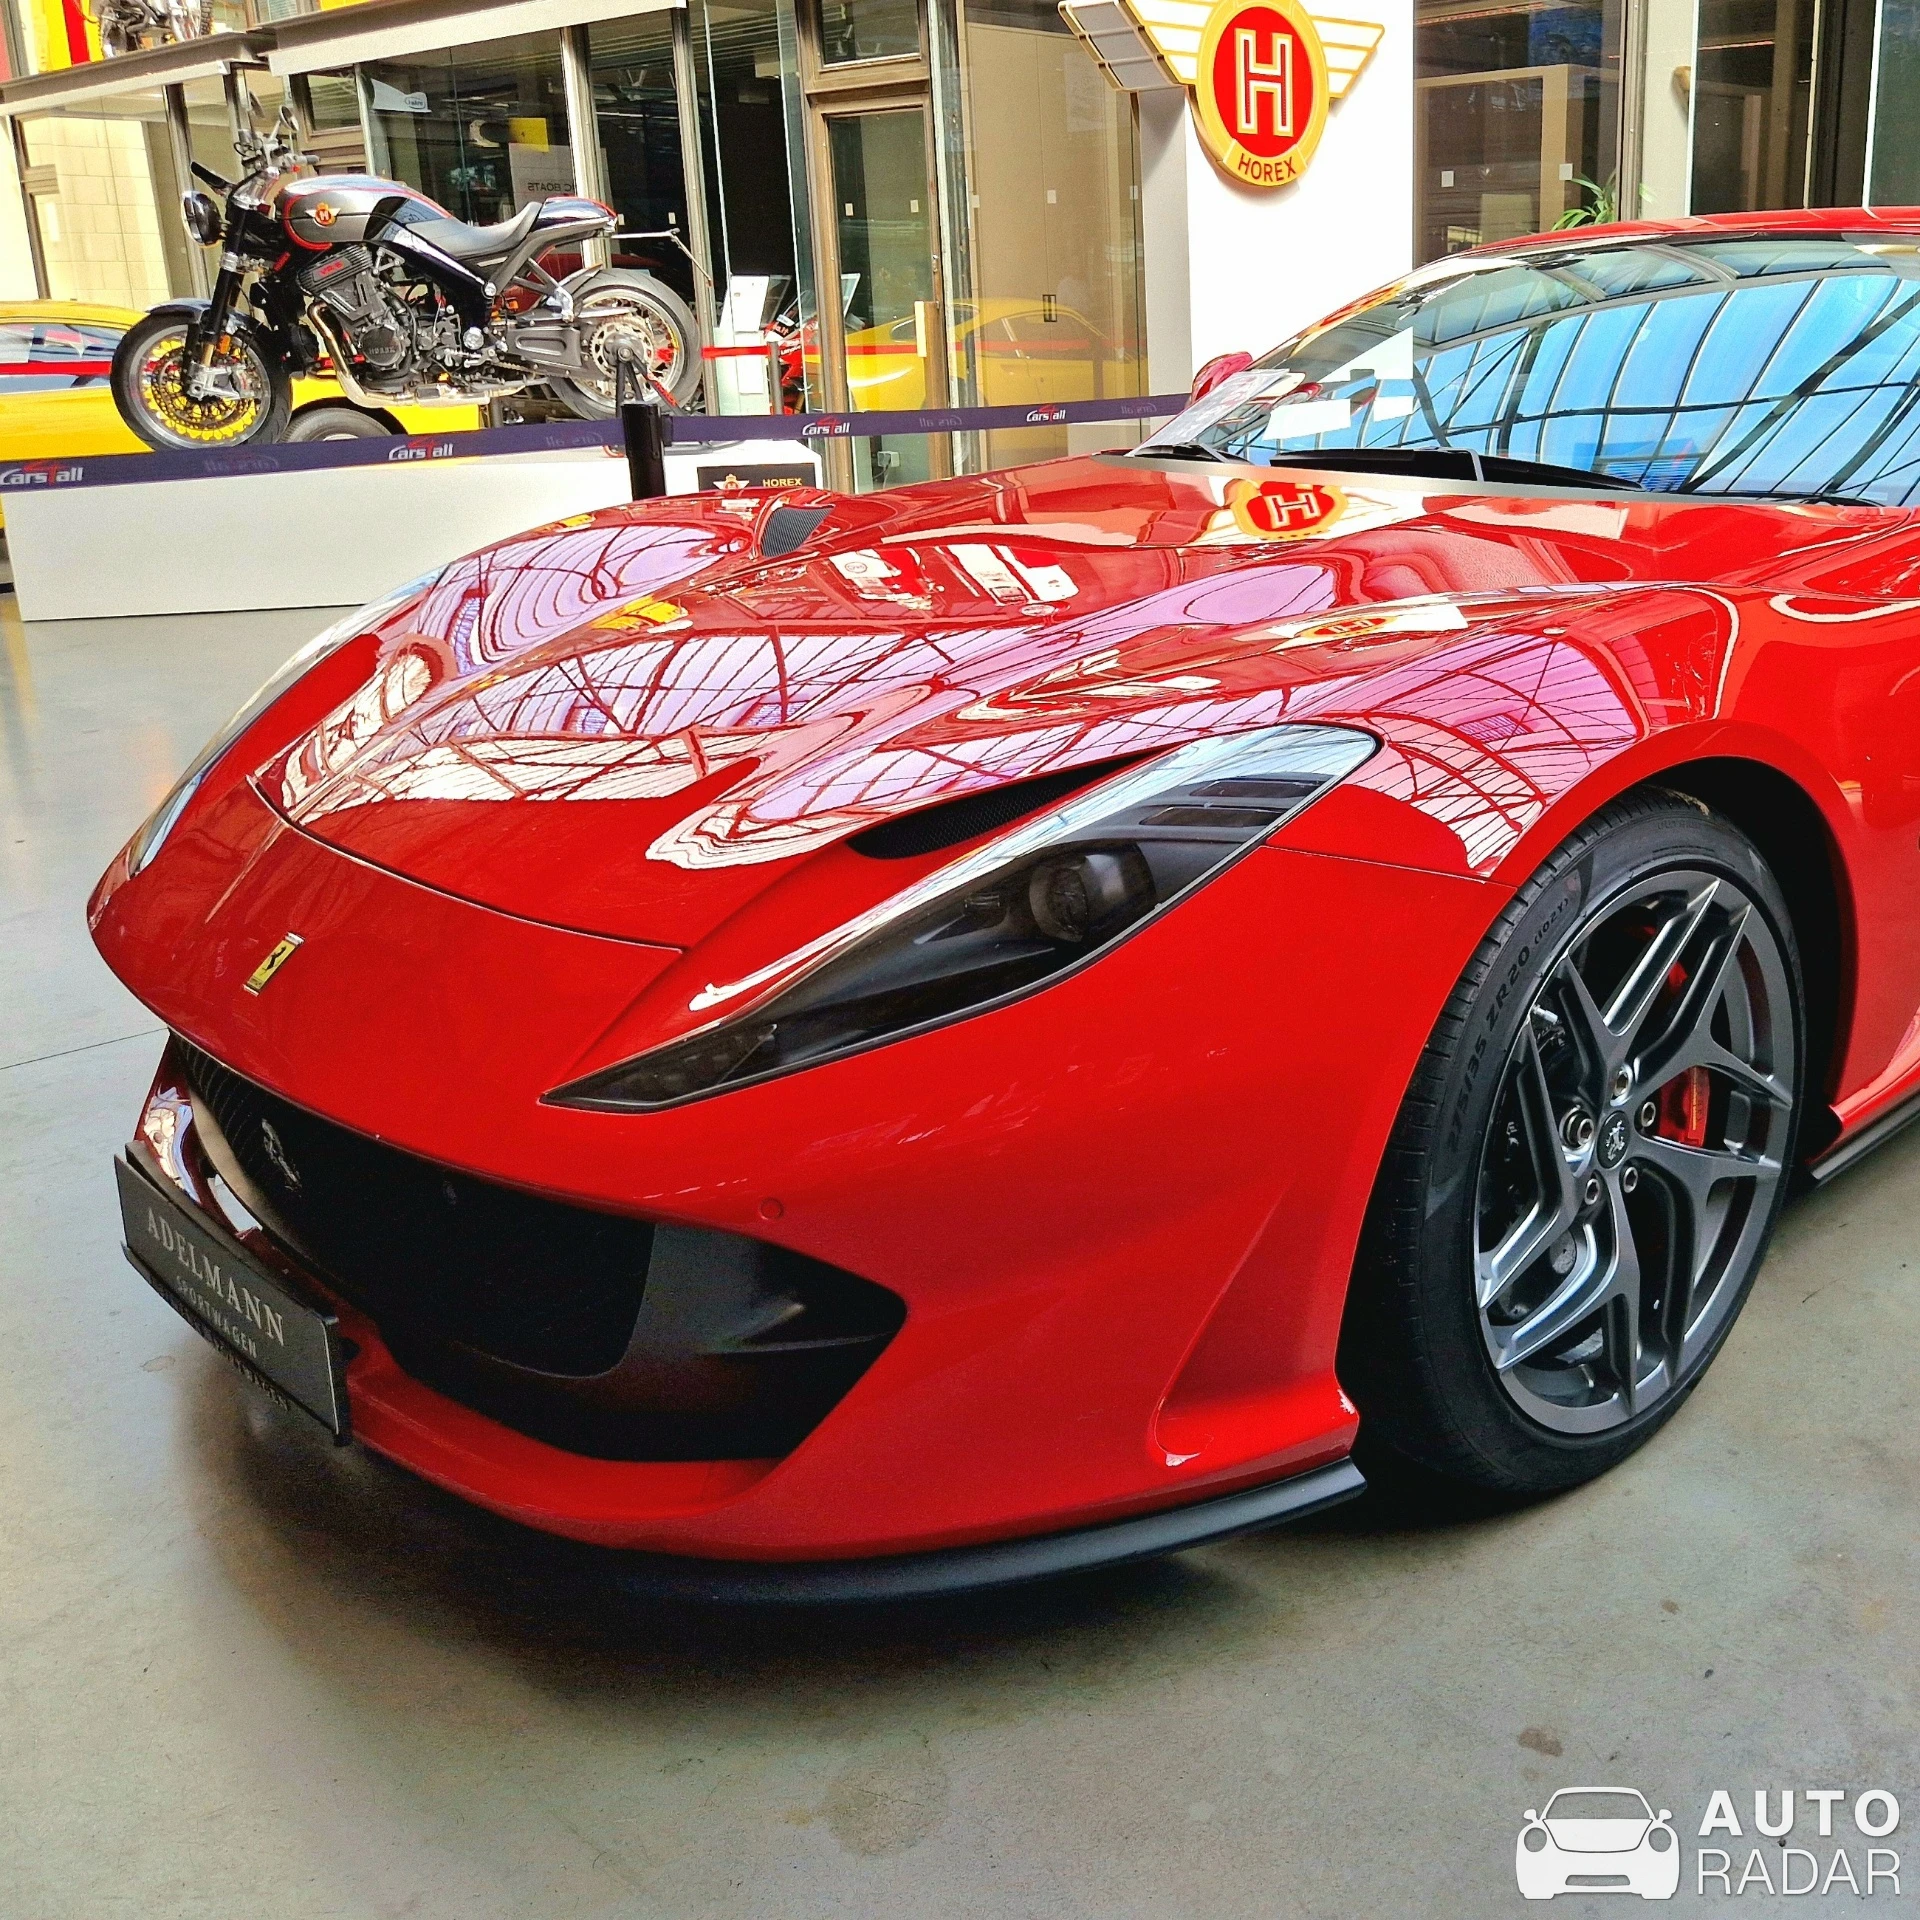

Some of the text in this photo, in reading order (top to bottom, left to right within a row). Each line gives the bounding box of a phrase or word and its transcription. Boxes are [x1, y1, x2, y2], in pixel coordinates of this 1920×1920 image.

[1235, 28, 1294, 138] H
[1238, 153, 1297, 183] HOREX
[802, 414, 850, 437] Cars4all
[1026, 404, 1066, 423] Cars4all
[388, 435, 454, 461] Cars4all
[0, 459, 84, 486] Cars4all
[762, 477, 803, 488] HOREX
[1447, 897, 1571, 1153] 275/35 ZR20 (102Y)
[148, 1206, 285, 1347] ADELMANN
